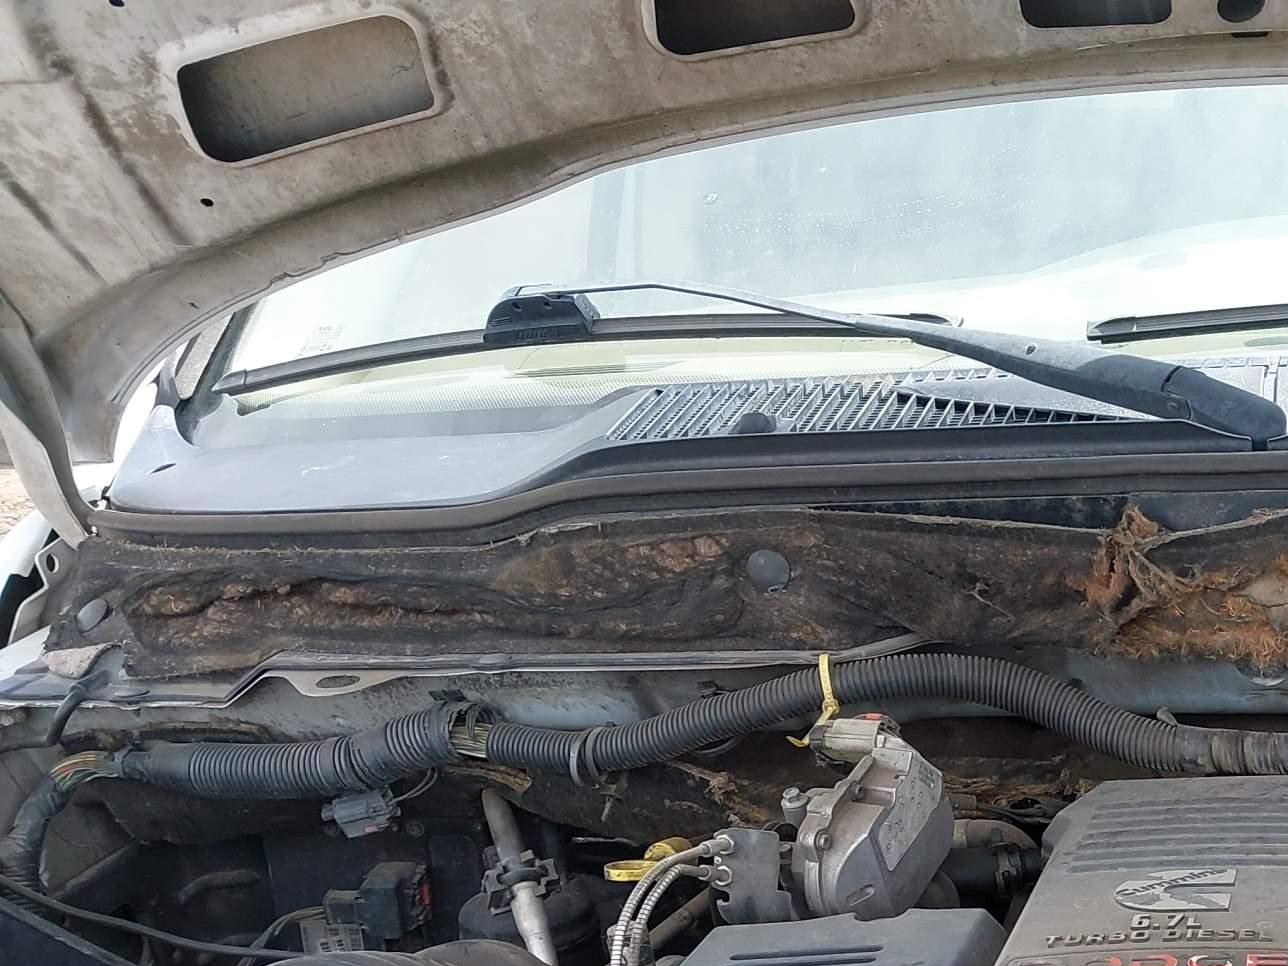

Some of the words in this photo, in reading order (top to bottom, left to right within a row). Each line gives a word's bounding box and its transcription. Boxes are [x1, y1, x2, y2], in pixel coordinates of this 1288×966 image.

[1115, 868, 1228, 896] Cummins
[1130, 913, 1202, 931] 6.7L
[1046, 930, 1150, 949] TURBO
[1162, 928, 1274, 943] DIESEL
